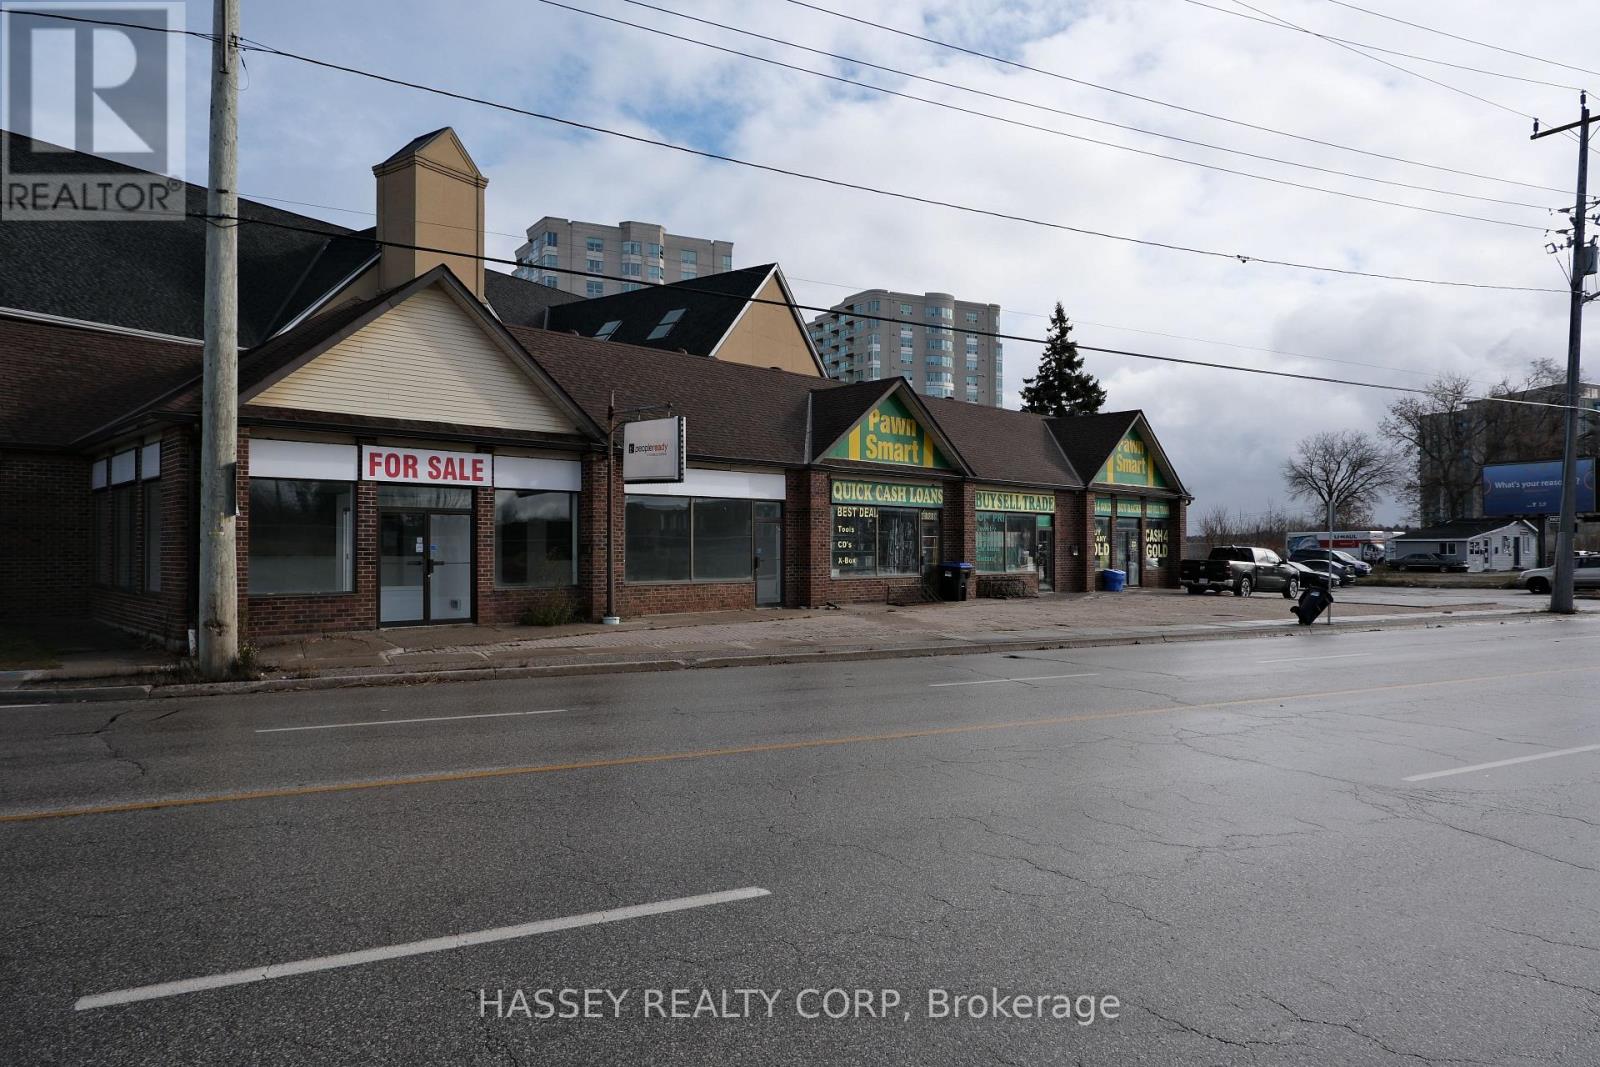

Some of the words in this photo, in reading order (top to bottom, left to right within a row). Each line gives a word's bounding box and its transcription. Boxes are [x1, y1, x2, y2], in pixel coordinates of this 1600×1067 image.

[868, 408, 917, 437] Pawn
[865, 434, 919, 463] Smart
[369, 452, 418, 479] FOR
[427, 455, 484, 482] SALE
[1117, 455, 1145, 474] Smart
[833, 481, 873, 501] QUICK
[875, 485, 906, 503] CASH
[909, 487, 943, 504] LOANS
[1494, 480, 1520, 489] What's
[1521, 480, 1540, 489] your
[976, 491, 998, 508] BUY
[997, 493, 1021, 509] SELL
[1022, 495, 1054, 511] TRADE
[837, 506, 857, 517] BEST
[859, 507, 878, 518] DEAL
[838, 525, 855, 533] Tools
[1145, 529, 1163, 543] CASH
[837, 541, 852, 549] CD's
[1146, 544, 1169, 558] GOLD
